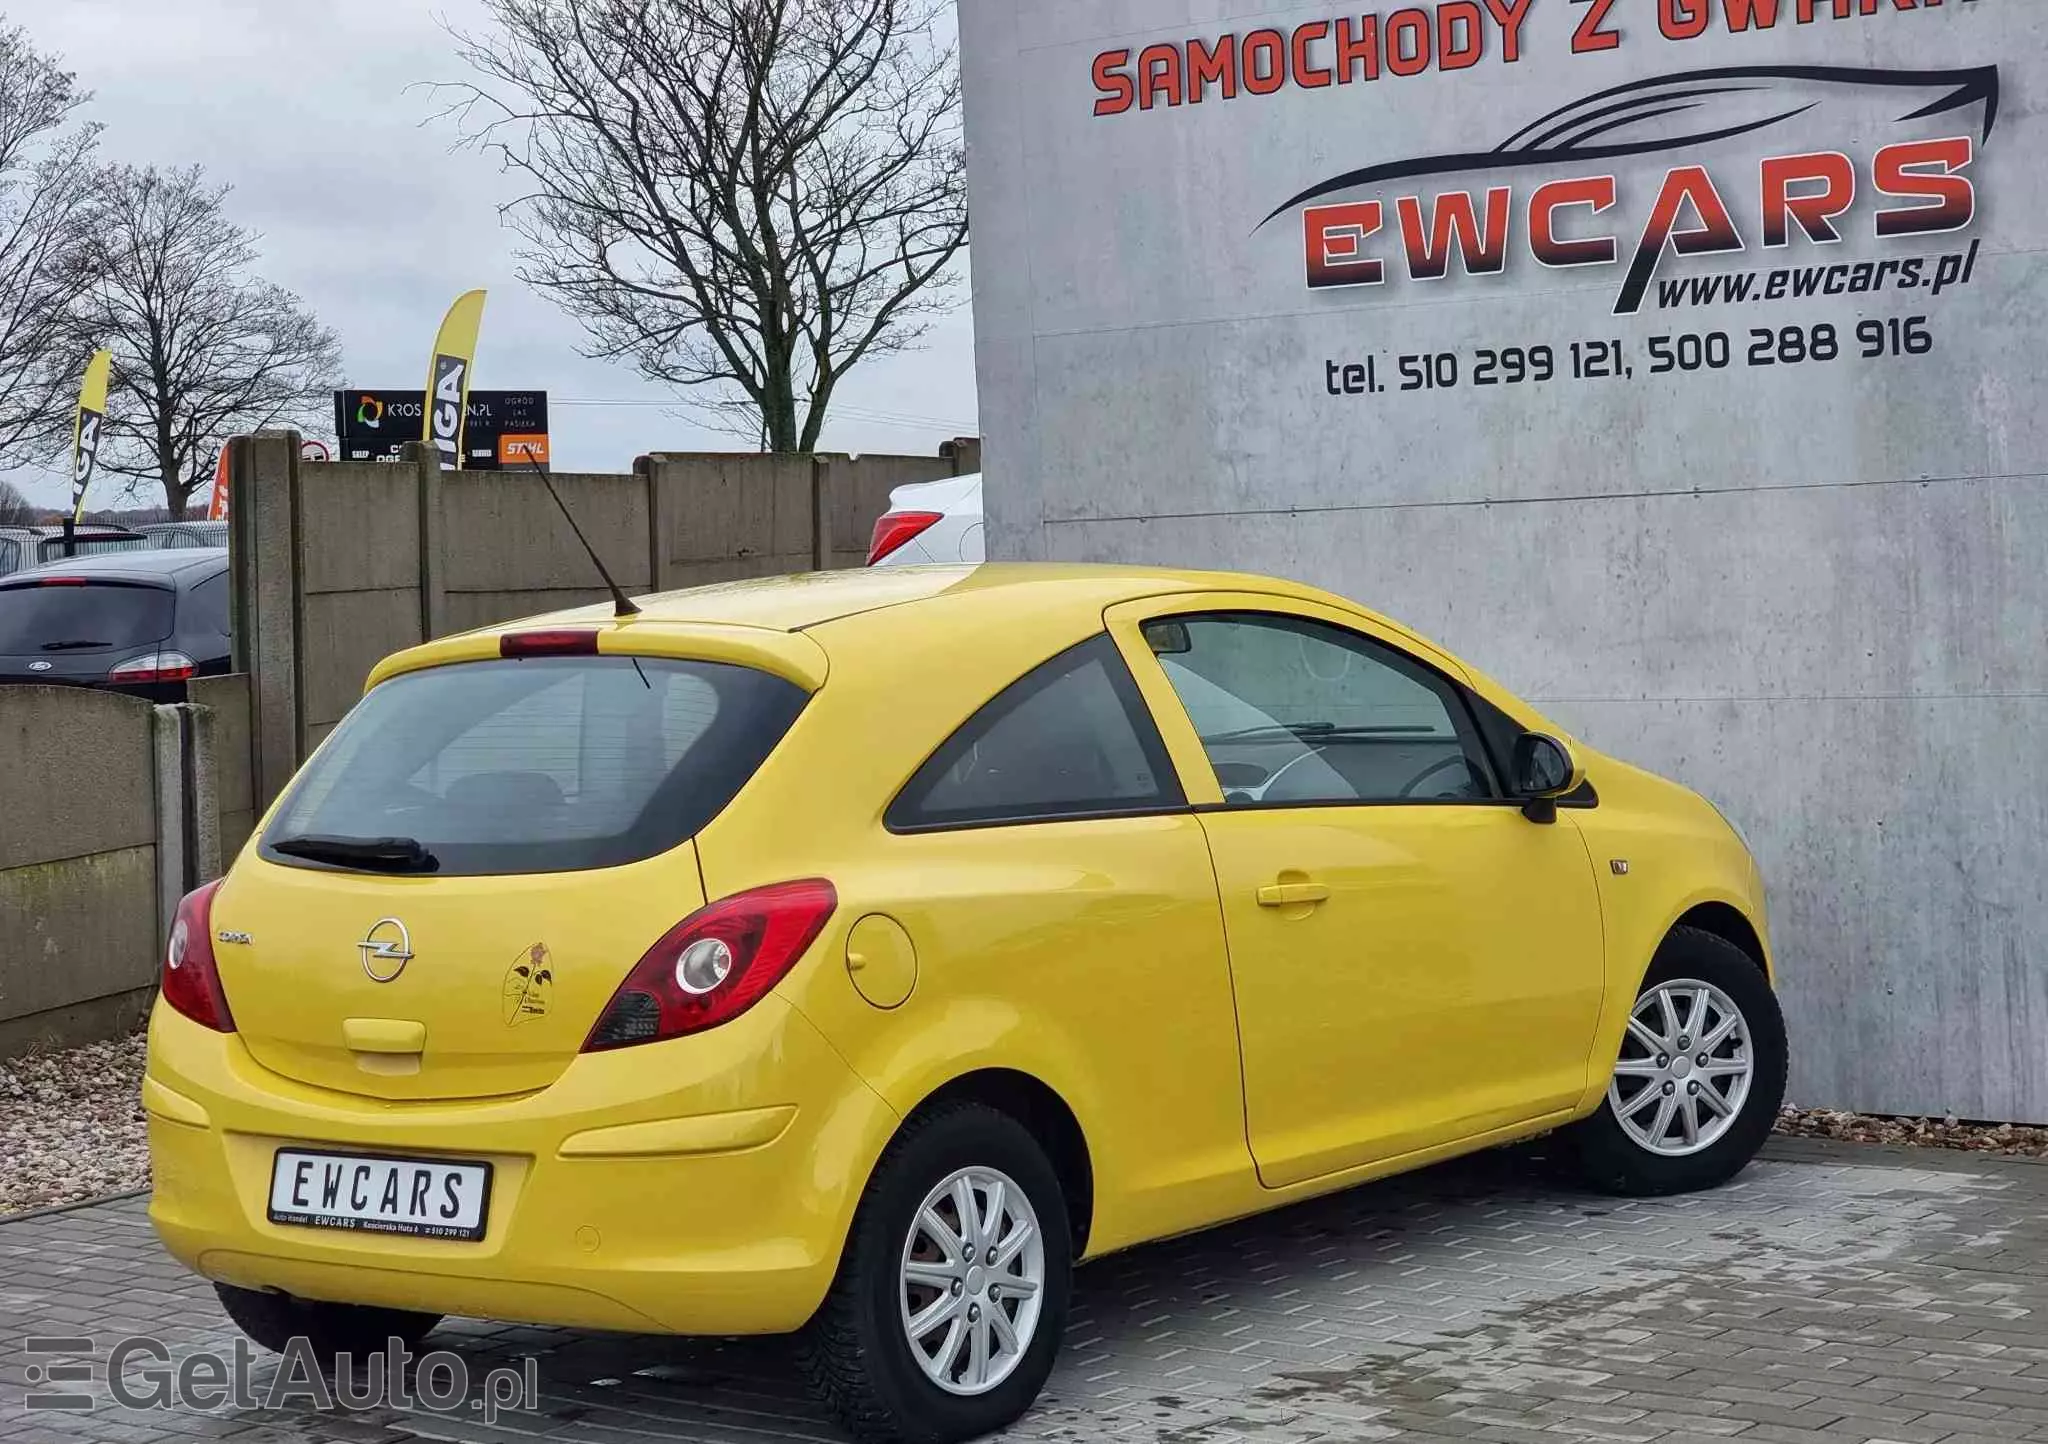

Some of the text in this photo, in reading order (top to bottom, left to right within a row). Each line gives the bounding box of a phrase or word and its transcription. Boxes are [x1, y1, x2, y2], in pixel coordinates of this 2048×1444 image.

[1092, 0, 1533, 117] SAMOCHODY
[1570, 0, 1621, 54] Z
[1302, 135, 1976, 316] EWCARS
[1658, 239, 1980, 309] www.ewcars.pl
[1326, 316, 1933, 396] tel. 510 299 121, 500 288 916
[292, 1160, 463, 1220] EWCARS
[315, 1215, 356, 1229] EWCARS
